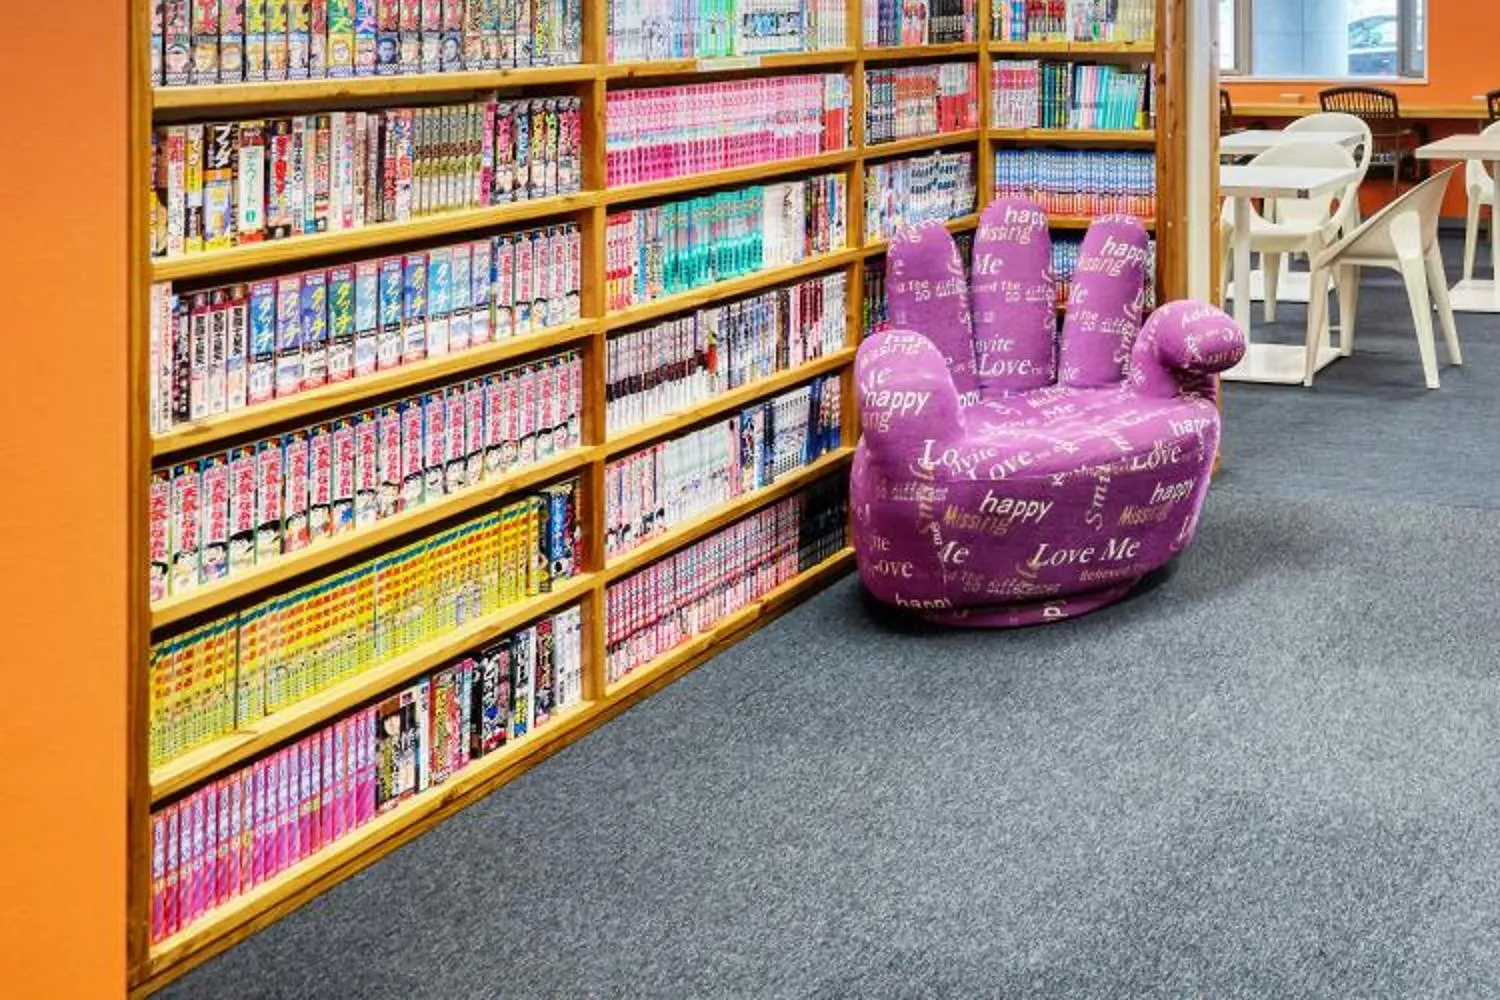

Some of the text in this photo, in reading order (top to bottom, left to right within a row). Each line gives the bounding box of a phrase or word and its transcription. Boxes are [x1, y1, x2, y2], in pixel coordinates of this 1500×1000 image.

[979, 354, 1032, 377] Love
[979, 489, 1053, 523] happy
[1029, 536, 1142, 567] Love Me
